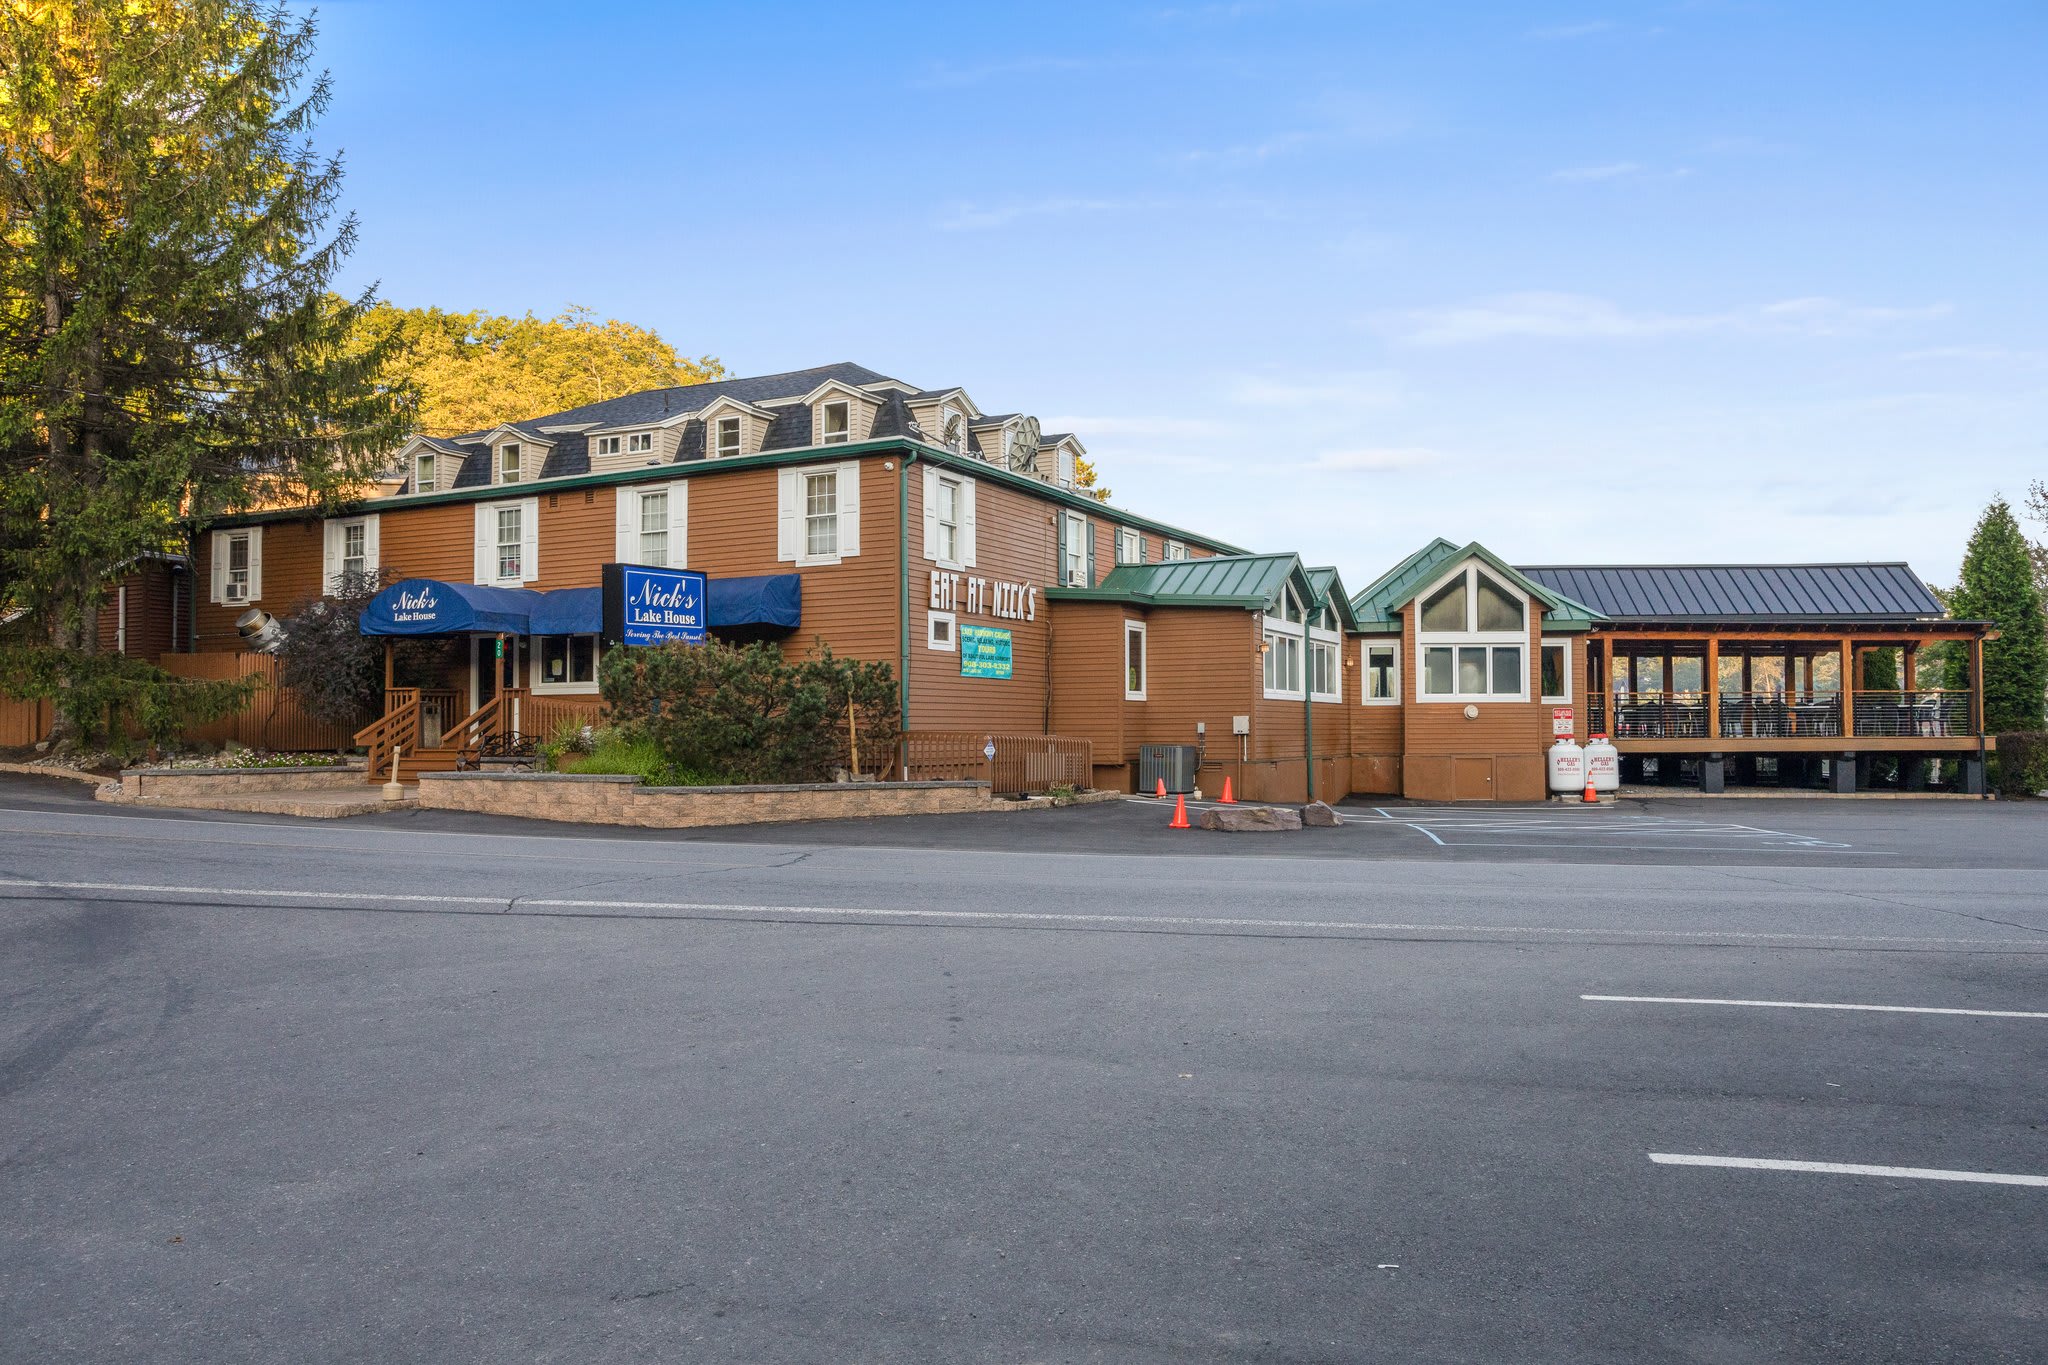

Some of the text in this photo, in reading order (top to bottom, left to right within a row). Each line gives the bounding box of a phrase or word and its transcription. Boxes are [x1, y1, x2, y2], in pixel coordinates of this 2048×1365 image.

[392, 587, 438, 610] Nick's
[630, 579, 698, 609] Nick's
[931, 571, 1037, 621] EAT AT NICK'S
[394, 612, 436, 621] Lake House
[634, 608, 695, 624] Lake House
[625, 628, 650, 641] Serving
[652, 630, 665, 639] The
[666, 631, 681, 640] Best
